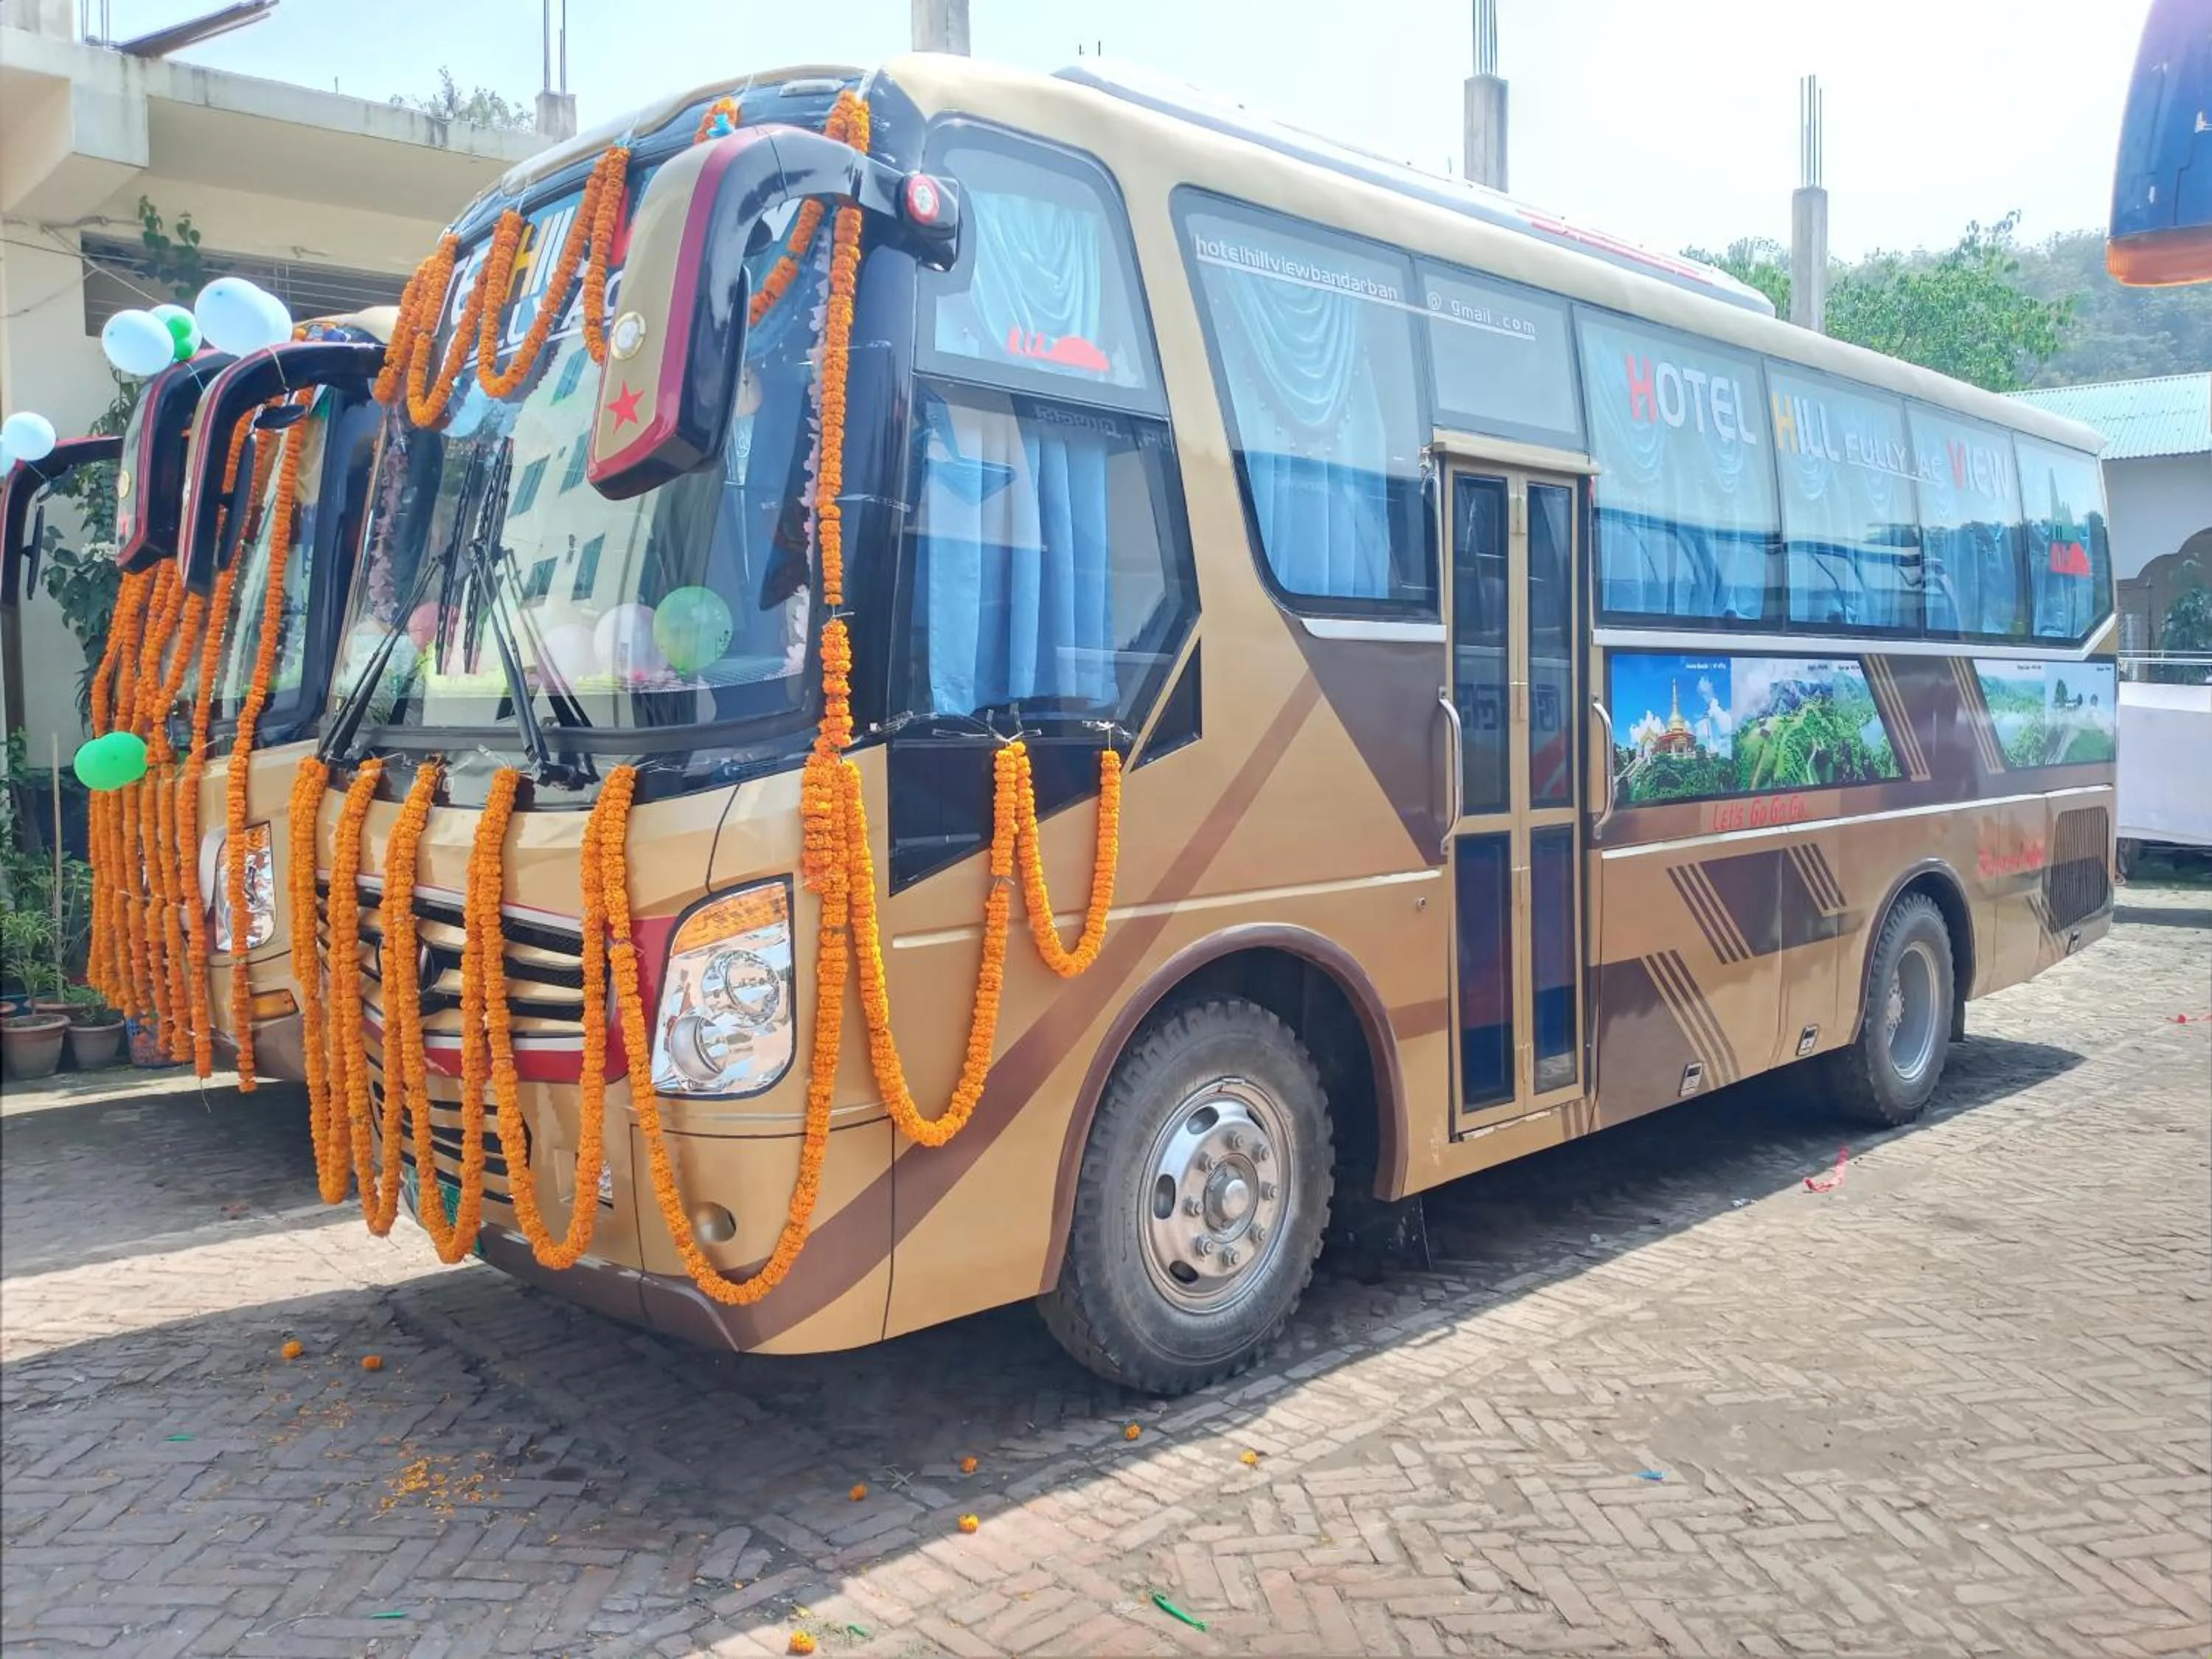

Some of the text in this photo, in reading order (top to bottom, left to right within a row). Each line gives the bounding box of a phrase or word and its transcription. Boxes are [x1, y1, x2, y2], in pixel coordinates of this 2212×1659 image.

[1195, 234, 1398, 301] hotelhillviewbandarban
[1427, 291, 1441, 310] @
[1626, 353, 2011, 500] HOTEL HILL VIEW
[1845, 432, 1906, 473] FULLY
